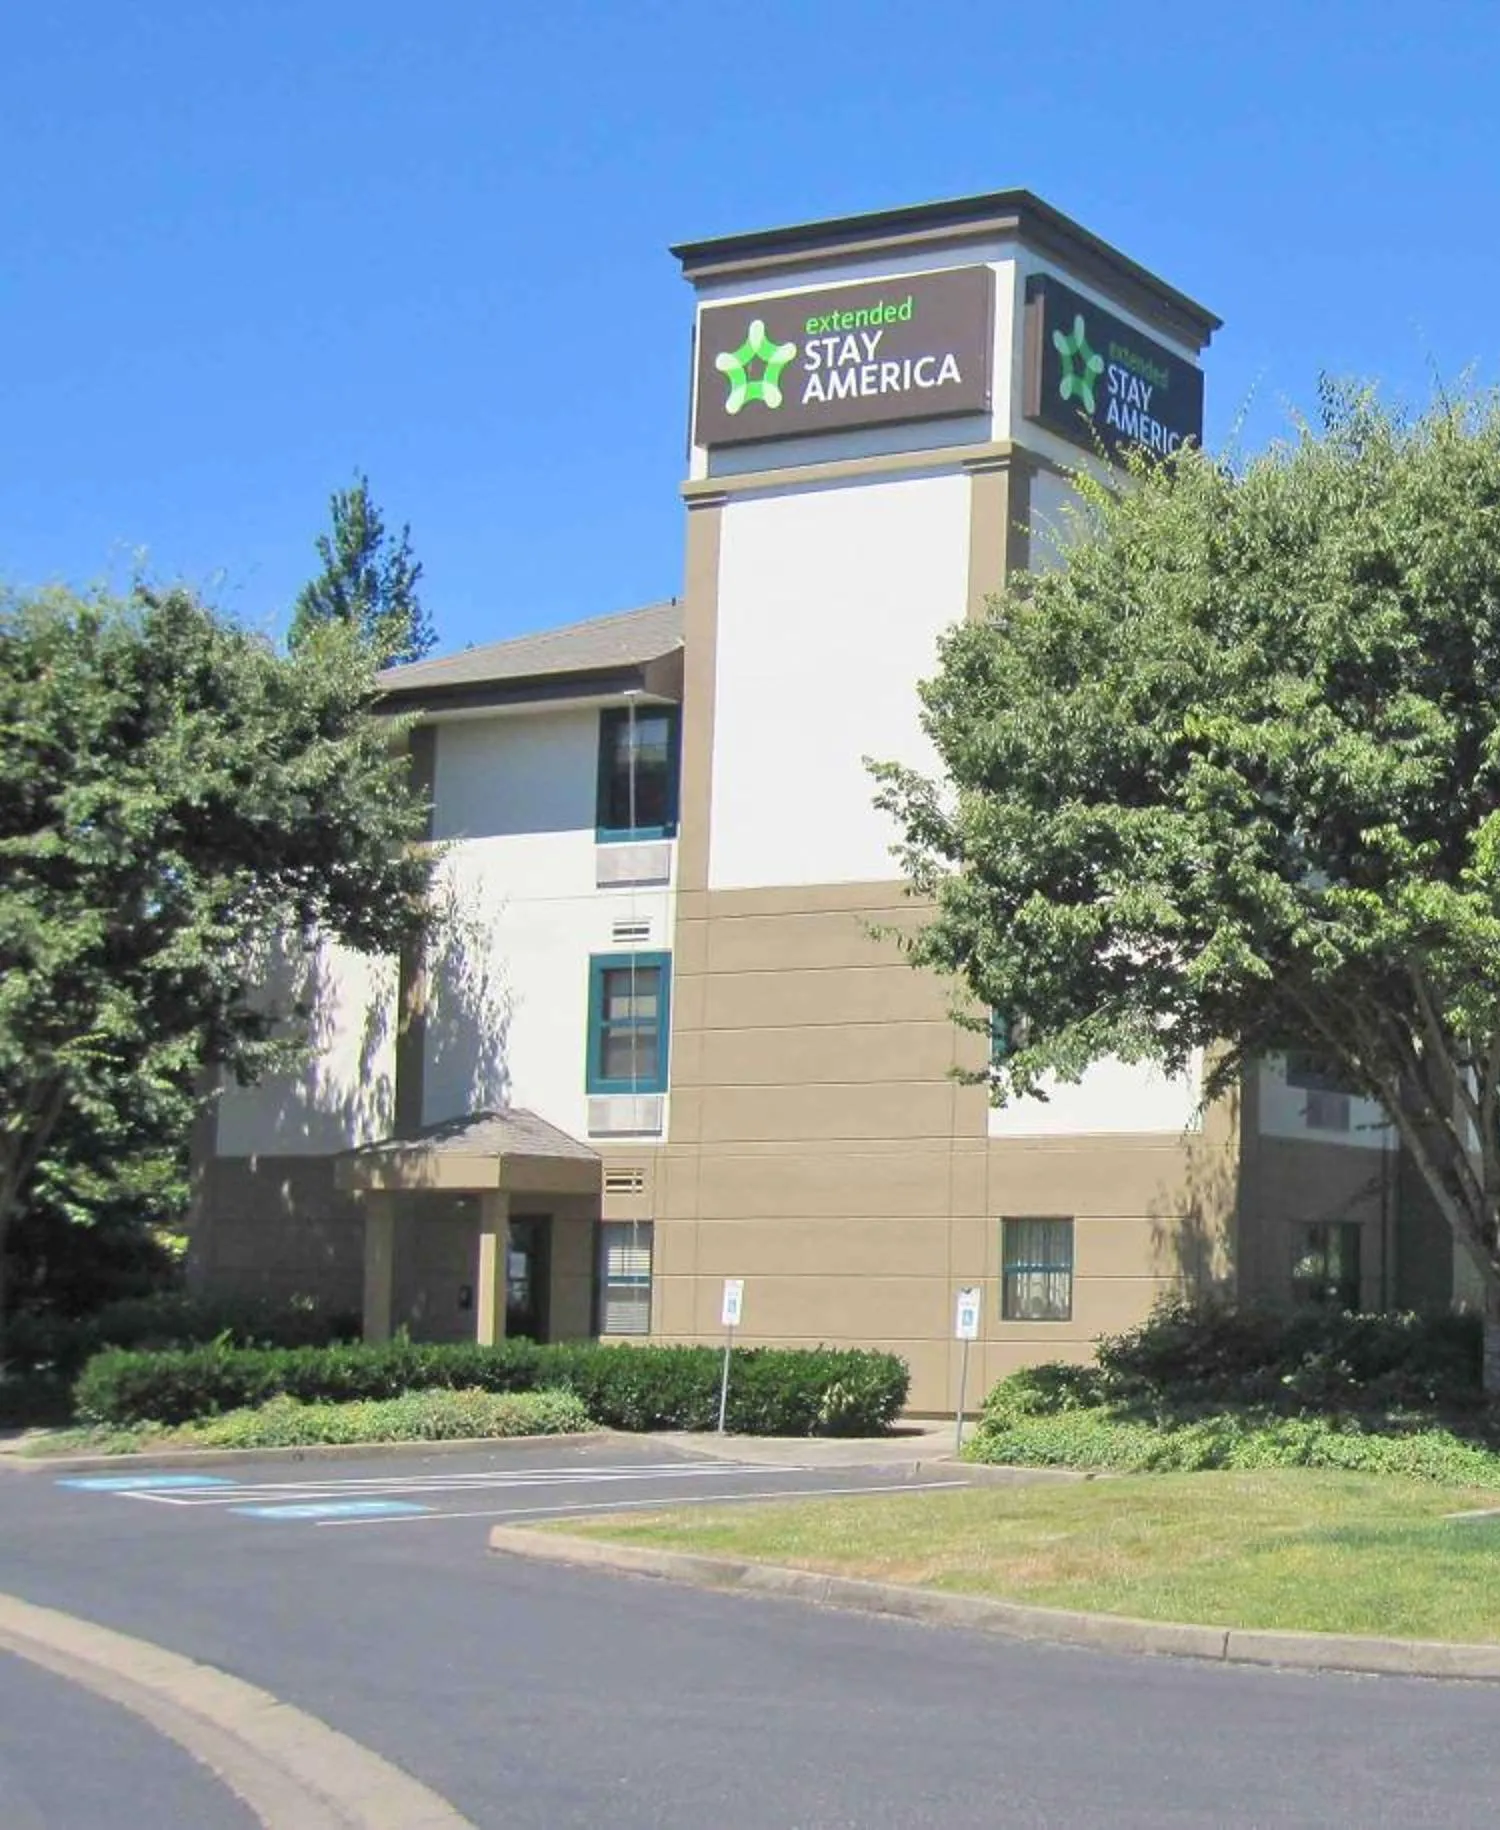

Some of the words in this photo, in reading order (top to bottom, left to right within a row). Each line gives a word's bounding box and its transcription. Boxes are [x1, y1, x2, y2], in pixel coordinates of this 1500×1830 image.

[805, 295, 913, 335] extended
[804, 330, 884, 371] STAY
[802, 353, 962, 405] AMERICA
[1108, 364, 1152, 412] STAY
[1107, 397, 1180, 455] AMERIC
